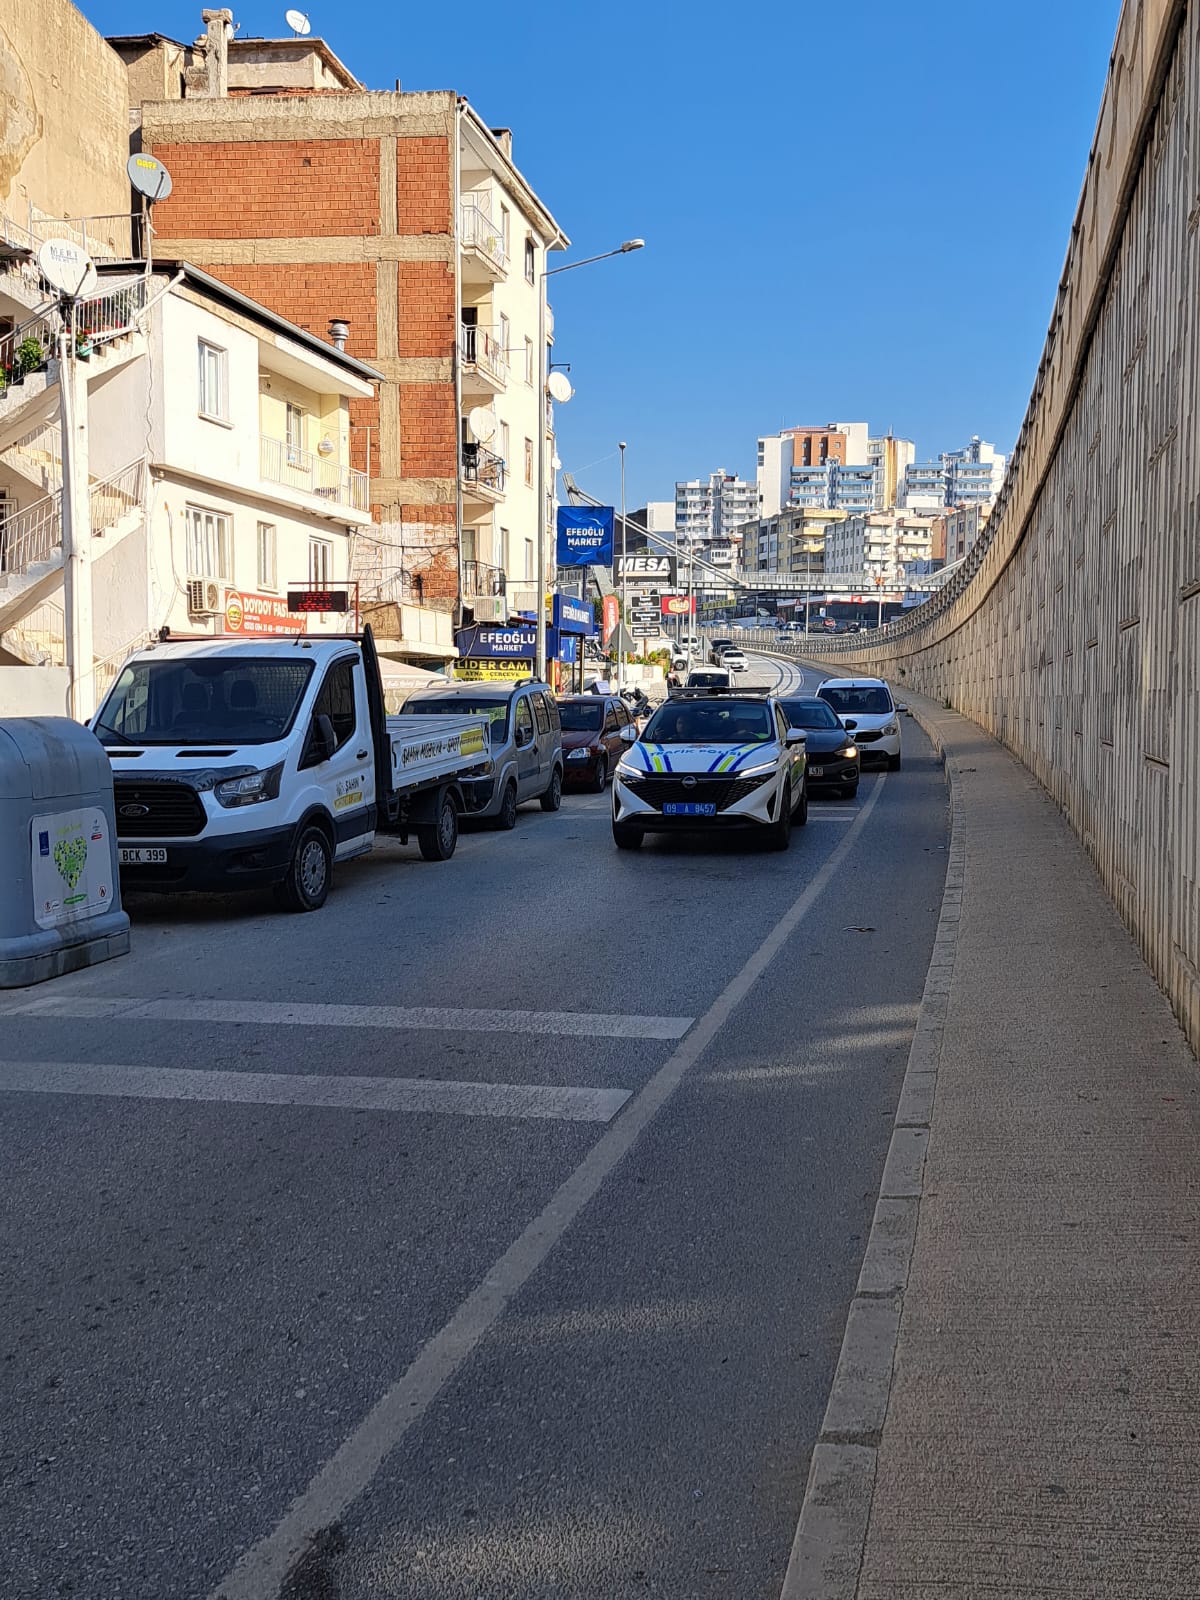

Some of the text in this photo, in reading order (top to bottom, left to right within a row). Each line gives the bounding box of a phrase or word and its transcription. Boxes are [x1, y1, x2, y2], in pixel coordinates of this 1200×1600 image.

[566, 526, 604, 537] EFEOĞLU
[568, 538, 602, 546] MARKET
[618, 558, 671, 572] MESA
[243, 597, 272, 615] DOYDOY
[480, 631, 536, 644] EFEOĞLU
[492, 644, 523, 652] MARKET
[500, 661, 528, 670] CAM
[666, 804, 677, 813] 09
[122, 849, 165, 862] BCK 399
